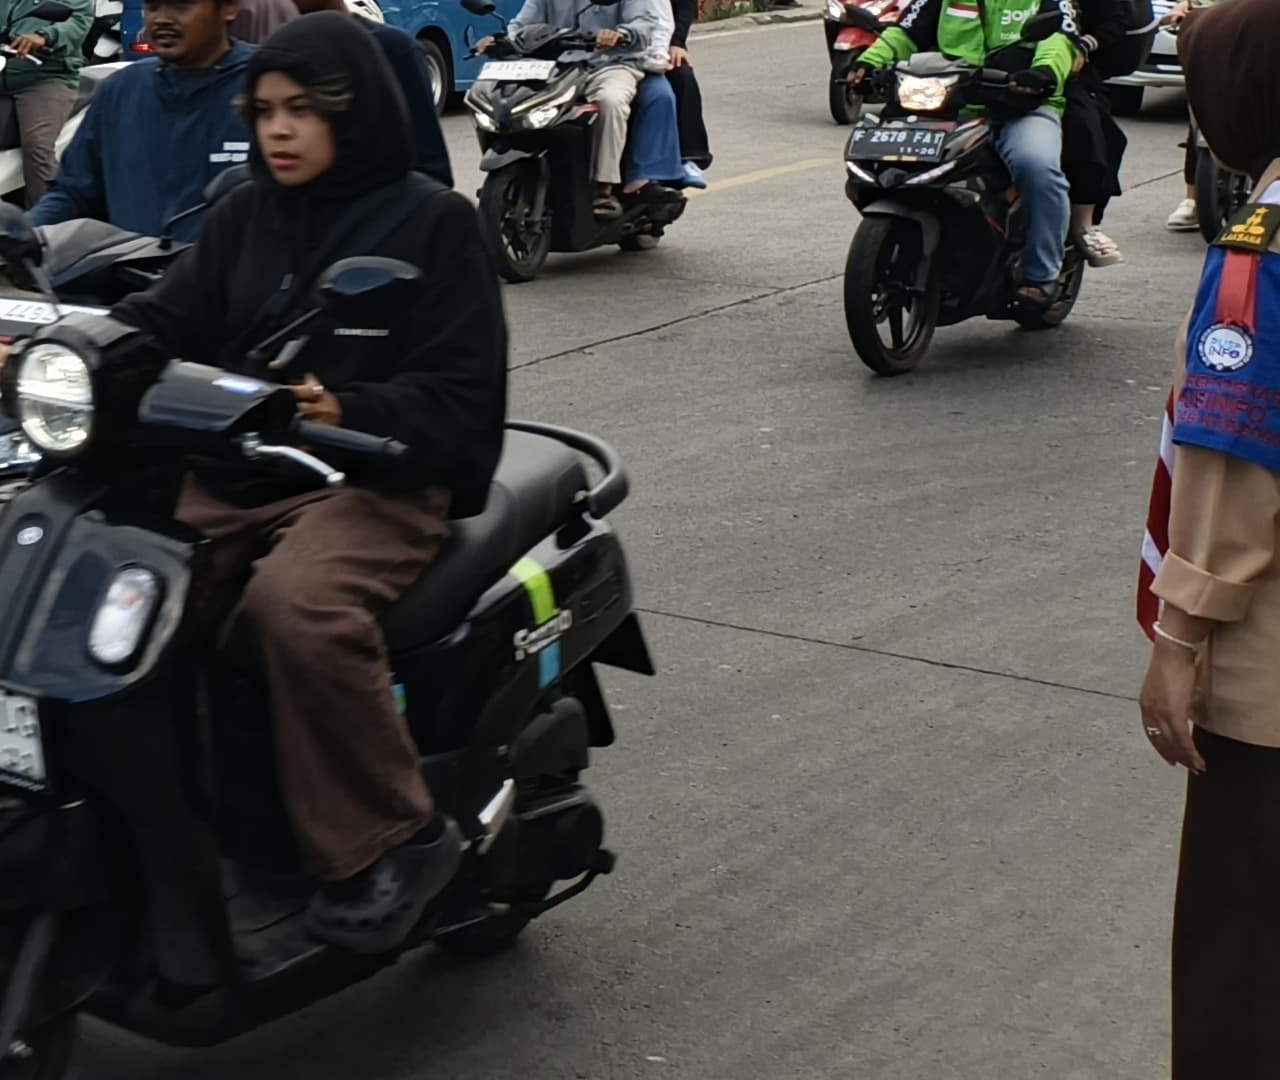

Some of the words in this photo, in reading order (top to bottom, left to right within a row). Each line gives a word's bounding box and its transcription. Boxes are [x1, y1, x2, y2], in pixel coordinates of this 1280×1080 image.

[852, 129, 866, 142] F
[912, 131, 945, 144] FAT
[1208, 345, 1240, 359] INFO
